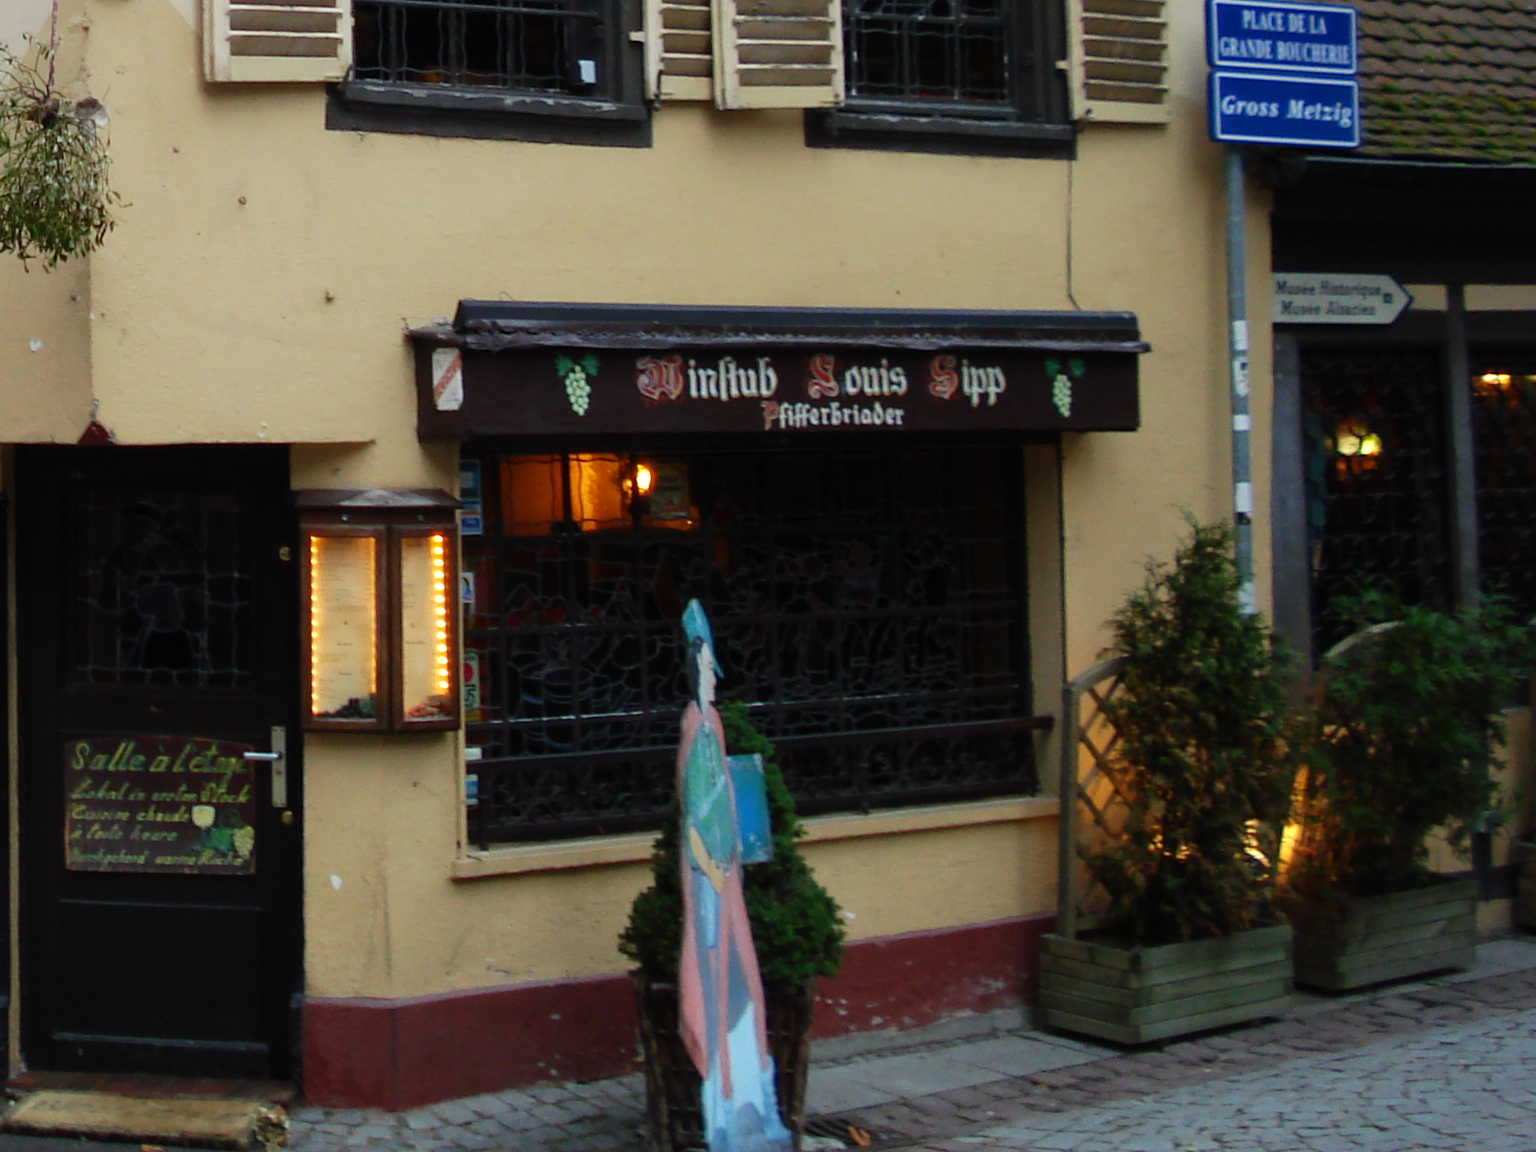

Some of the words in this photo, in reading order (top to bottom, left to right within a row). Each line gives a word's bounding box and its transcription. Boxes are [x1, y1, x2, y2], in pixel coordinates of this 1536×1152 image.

[1242, 9, 1284, 31] PLACE
[1288, 13, 1306, 33] DE
[1309, 14, 1327, 35] LA
[1219, 36, 1273, 59] GRANDE
[1276, 40, 1350, 65] BOUCHERIE
[1221, 95, 1280, 118] Gross
[1286, 99, 1352, 128] Metzig
[807, 353, 908, 400] Louis
[929, 354, 1007, 408] Sipp
[761, 399, 905, 431] Pfifferbriader
[71, 741, 147, 772] Salle
